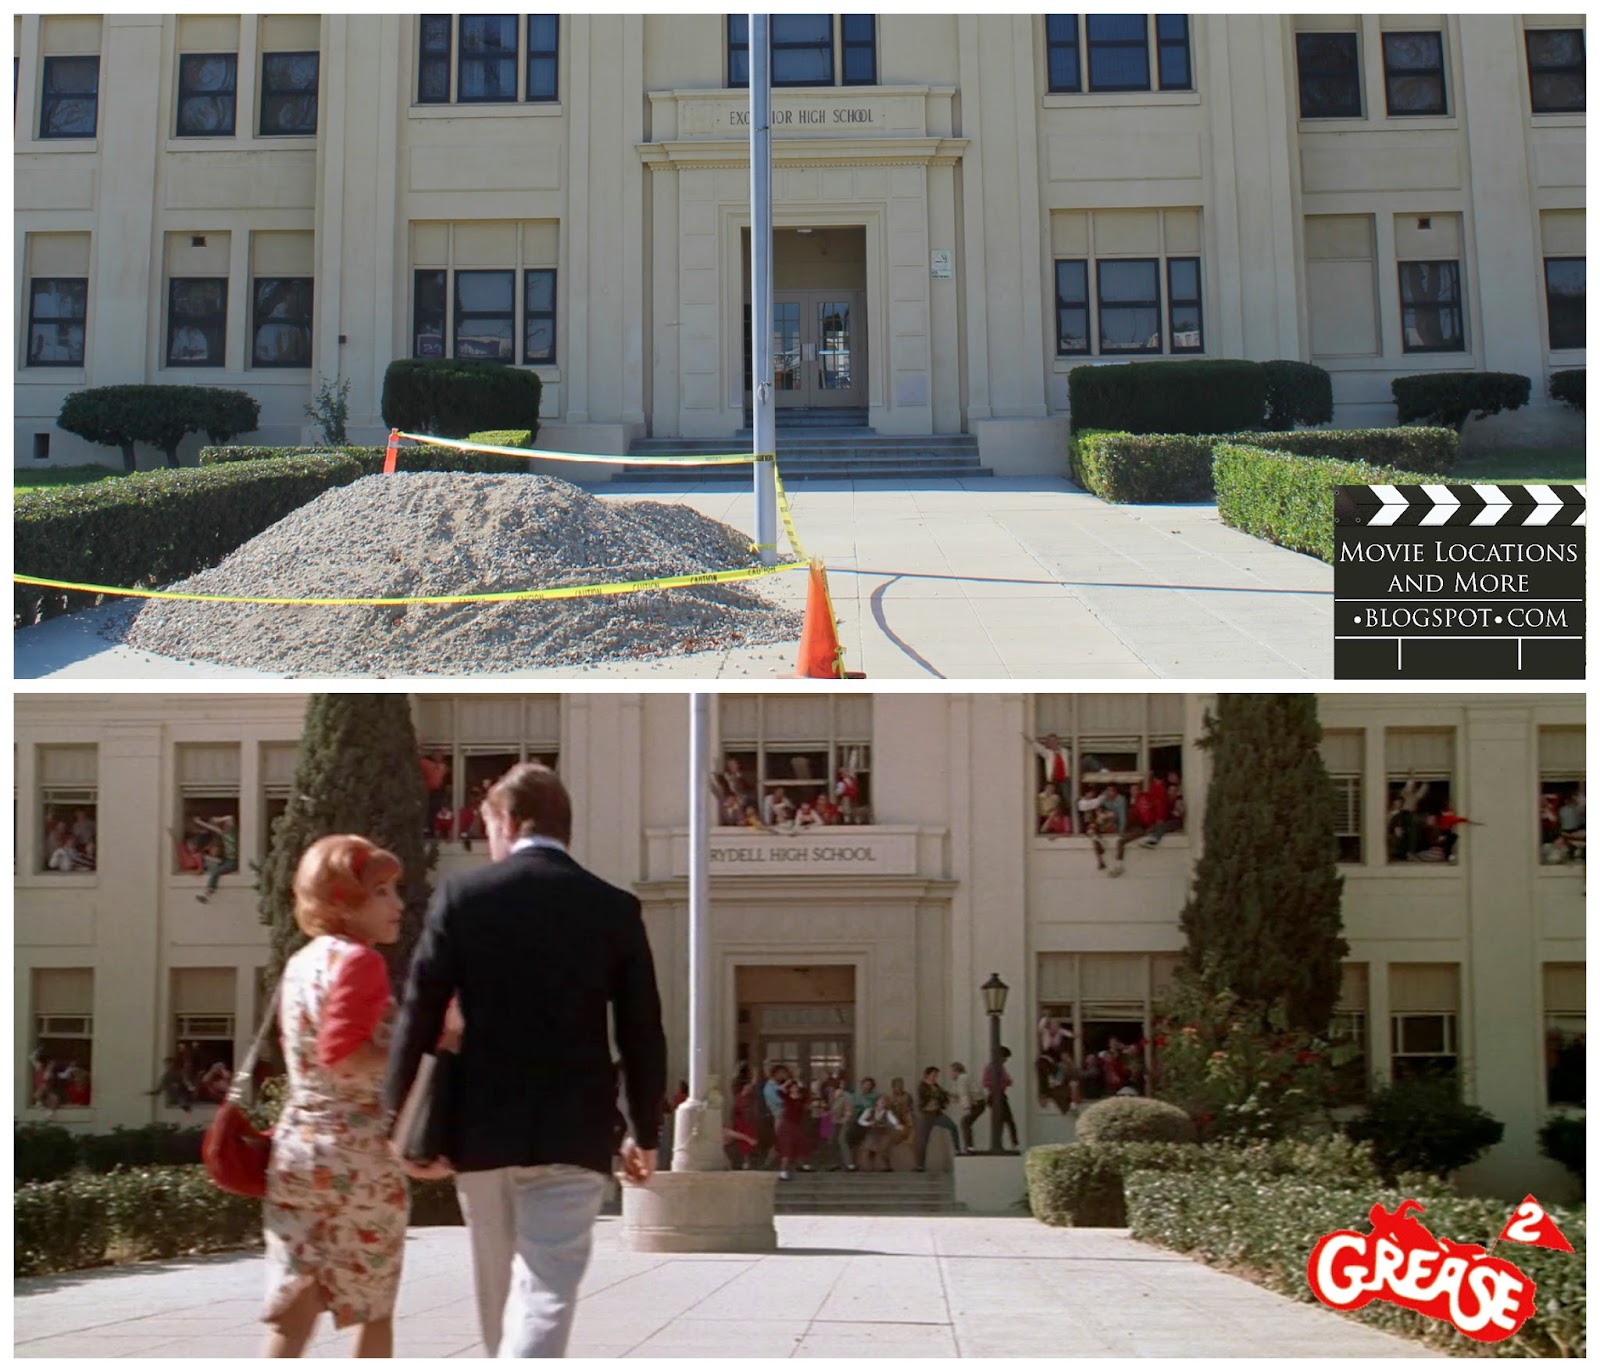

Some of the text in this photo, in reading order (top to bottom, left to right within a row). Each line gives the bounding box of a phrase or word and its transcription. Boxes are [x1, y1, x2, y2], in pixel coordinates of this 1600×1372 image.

[729, 108, 874, 126] EXCIOR HIGH SCHOOL
[689, 574, 718, 585] CAUTION
[709, 847, 877, 863] RYDELL HIGH SCHOOL
